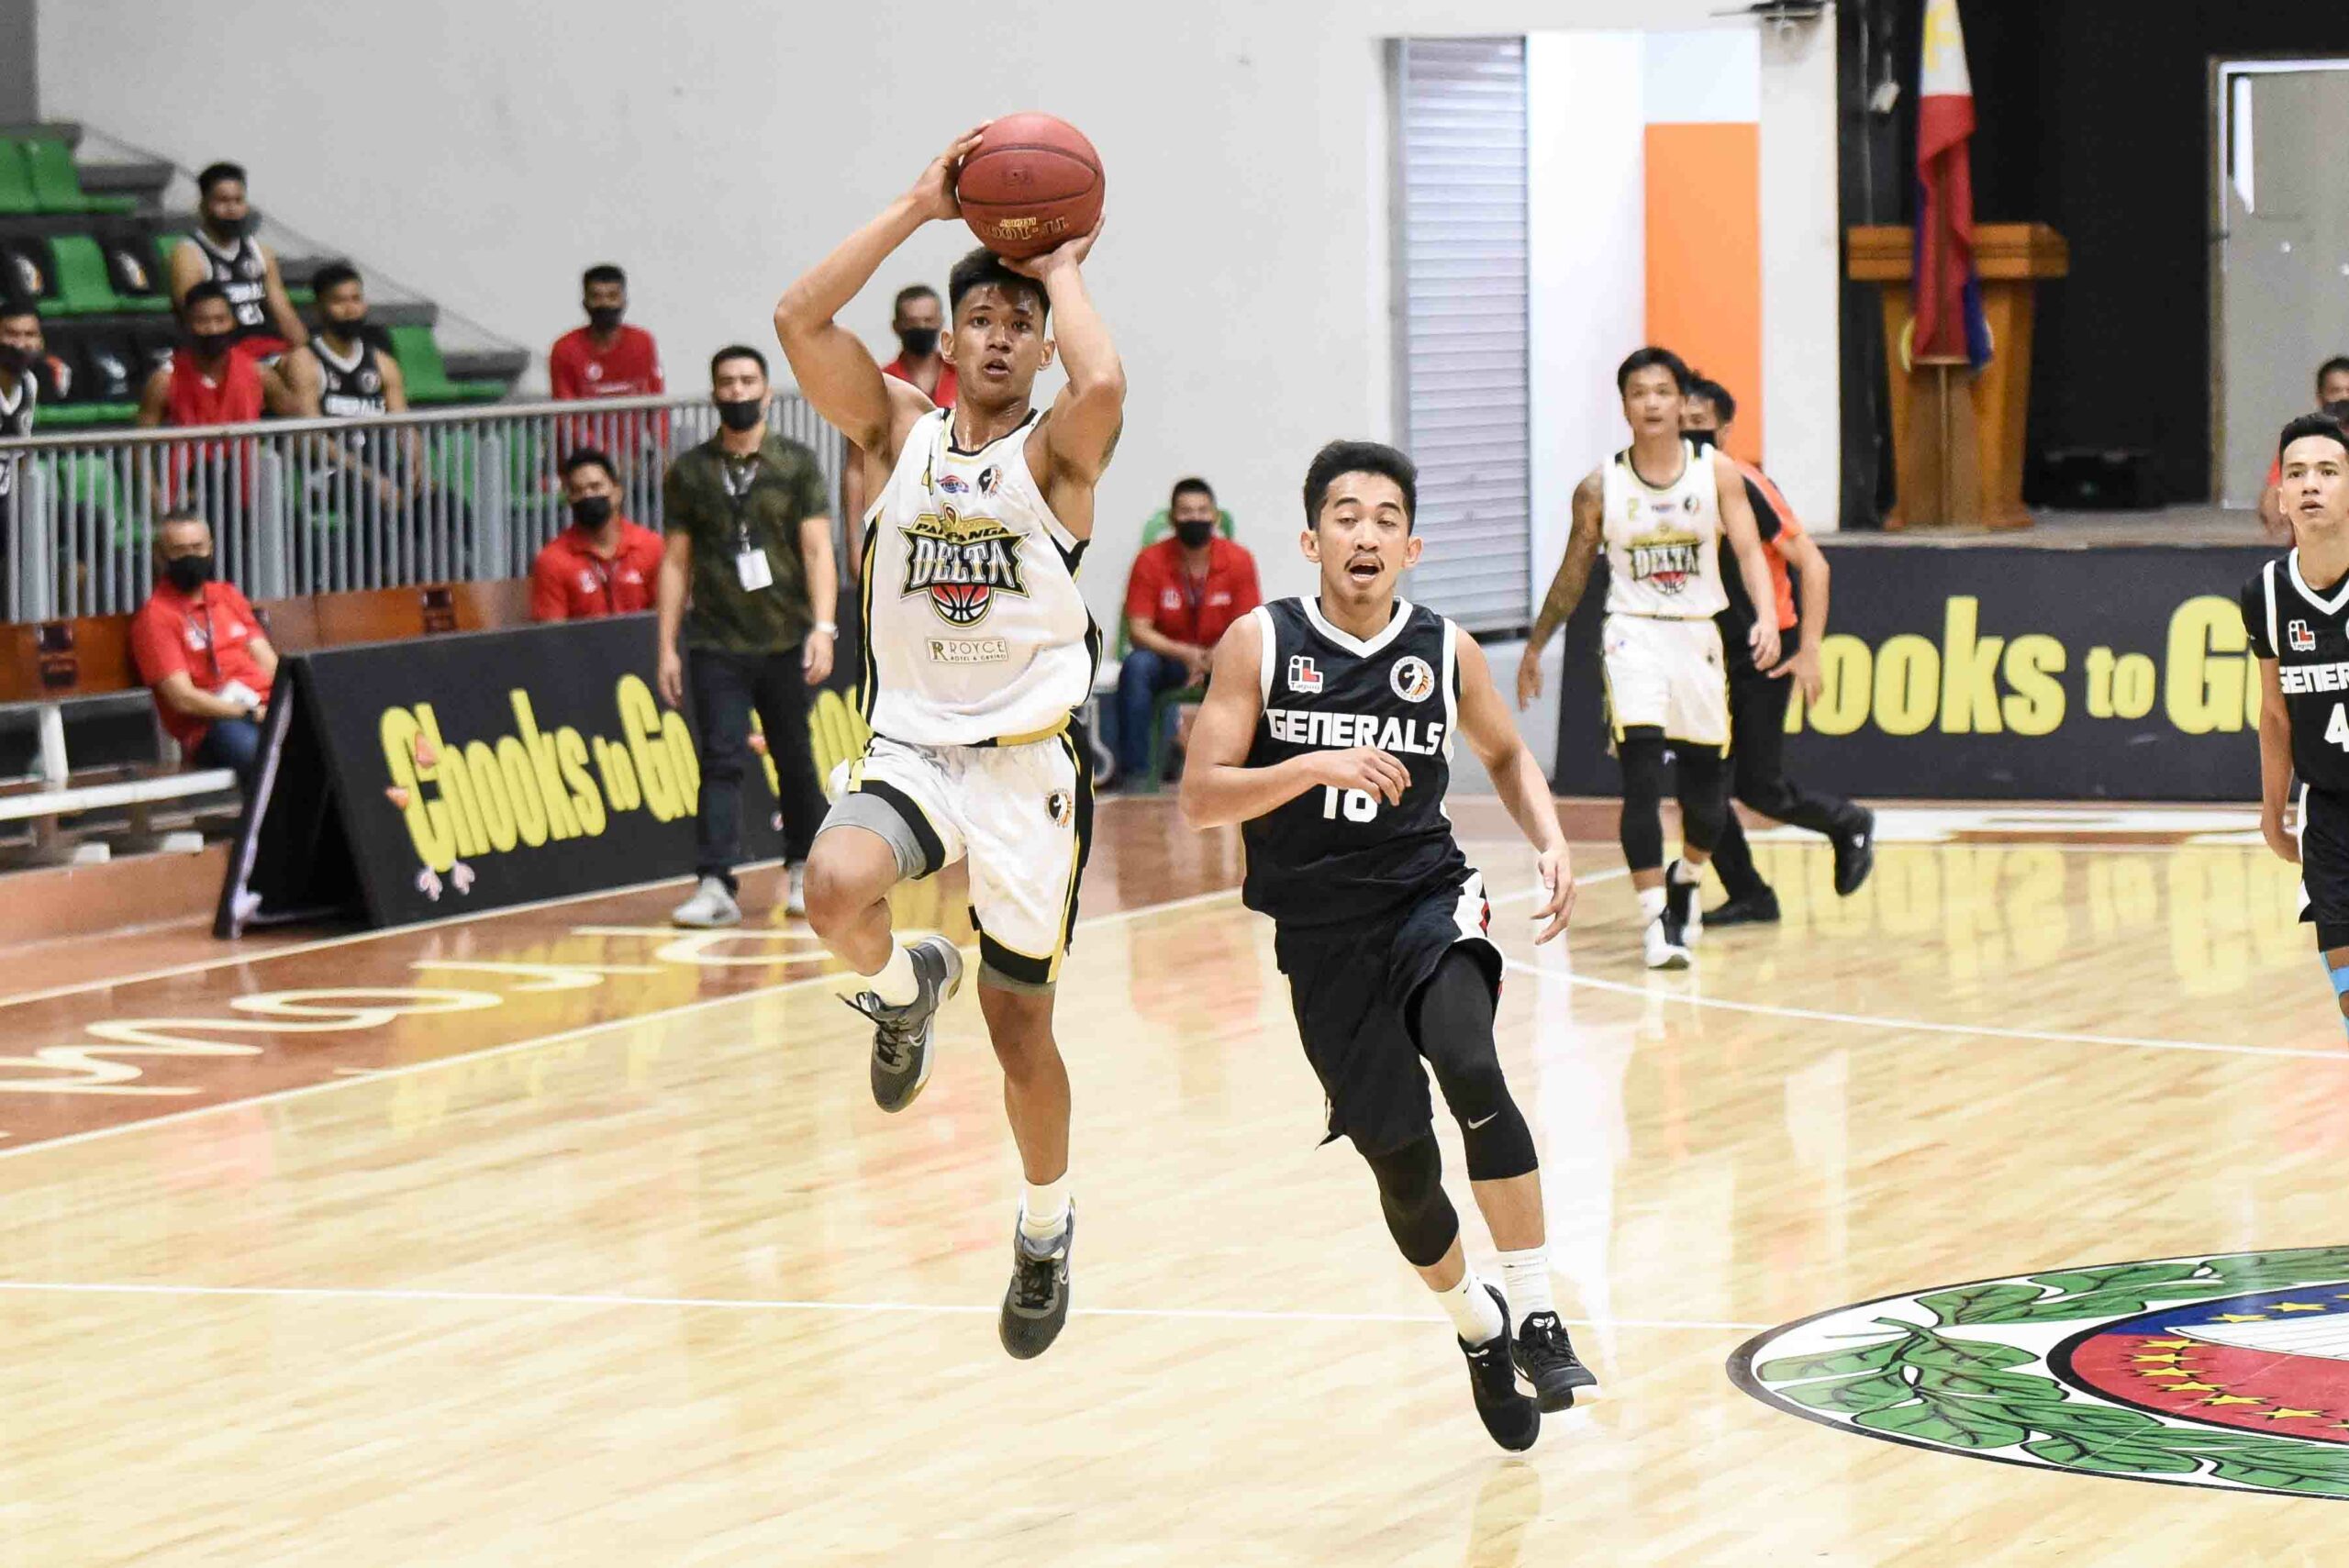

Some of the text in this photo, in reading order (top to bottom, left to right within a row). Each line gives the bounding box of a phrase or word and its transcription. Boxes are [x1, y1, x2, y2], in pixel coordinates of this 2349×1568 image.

[909, 538, 1016, 588] DELTA
[949, 640, 1006, 654] ROYCE
[2086, 646, 2156, 719] to
[2165, 595, 2261, 736] G
[616, 673, 702, 823] Go
[1266, 708, 1444, 755] GENERALS
[380, 689, 607, 873] Chooks
[591, 735, 642, 813] to
